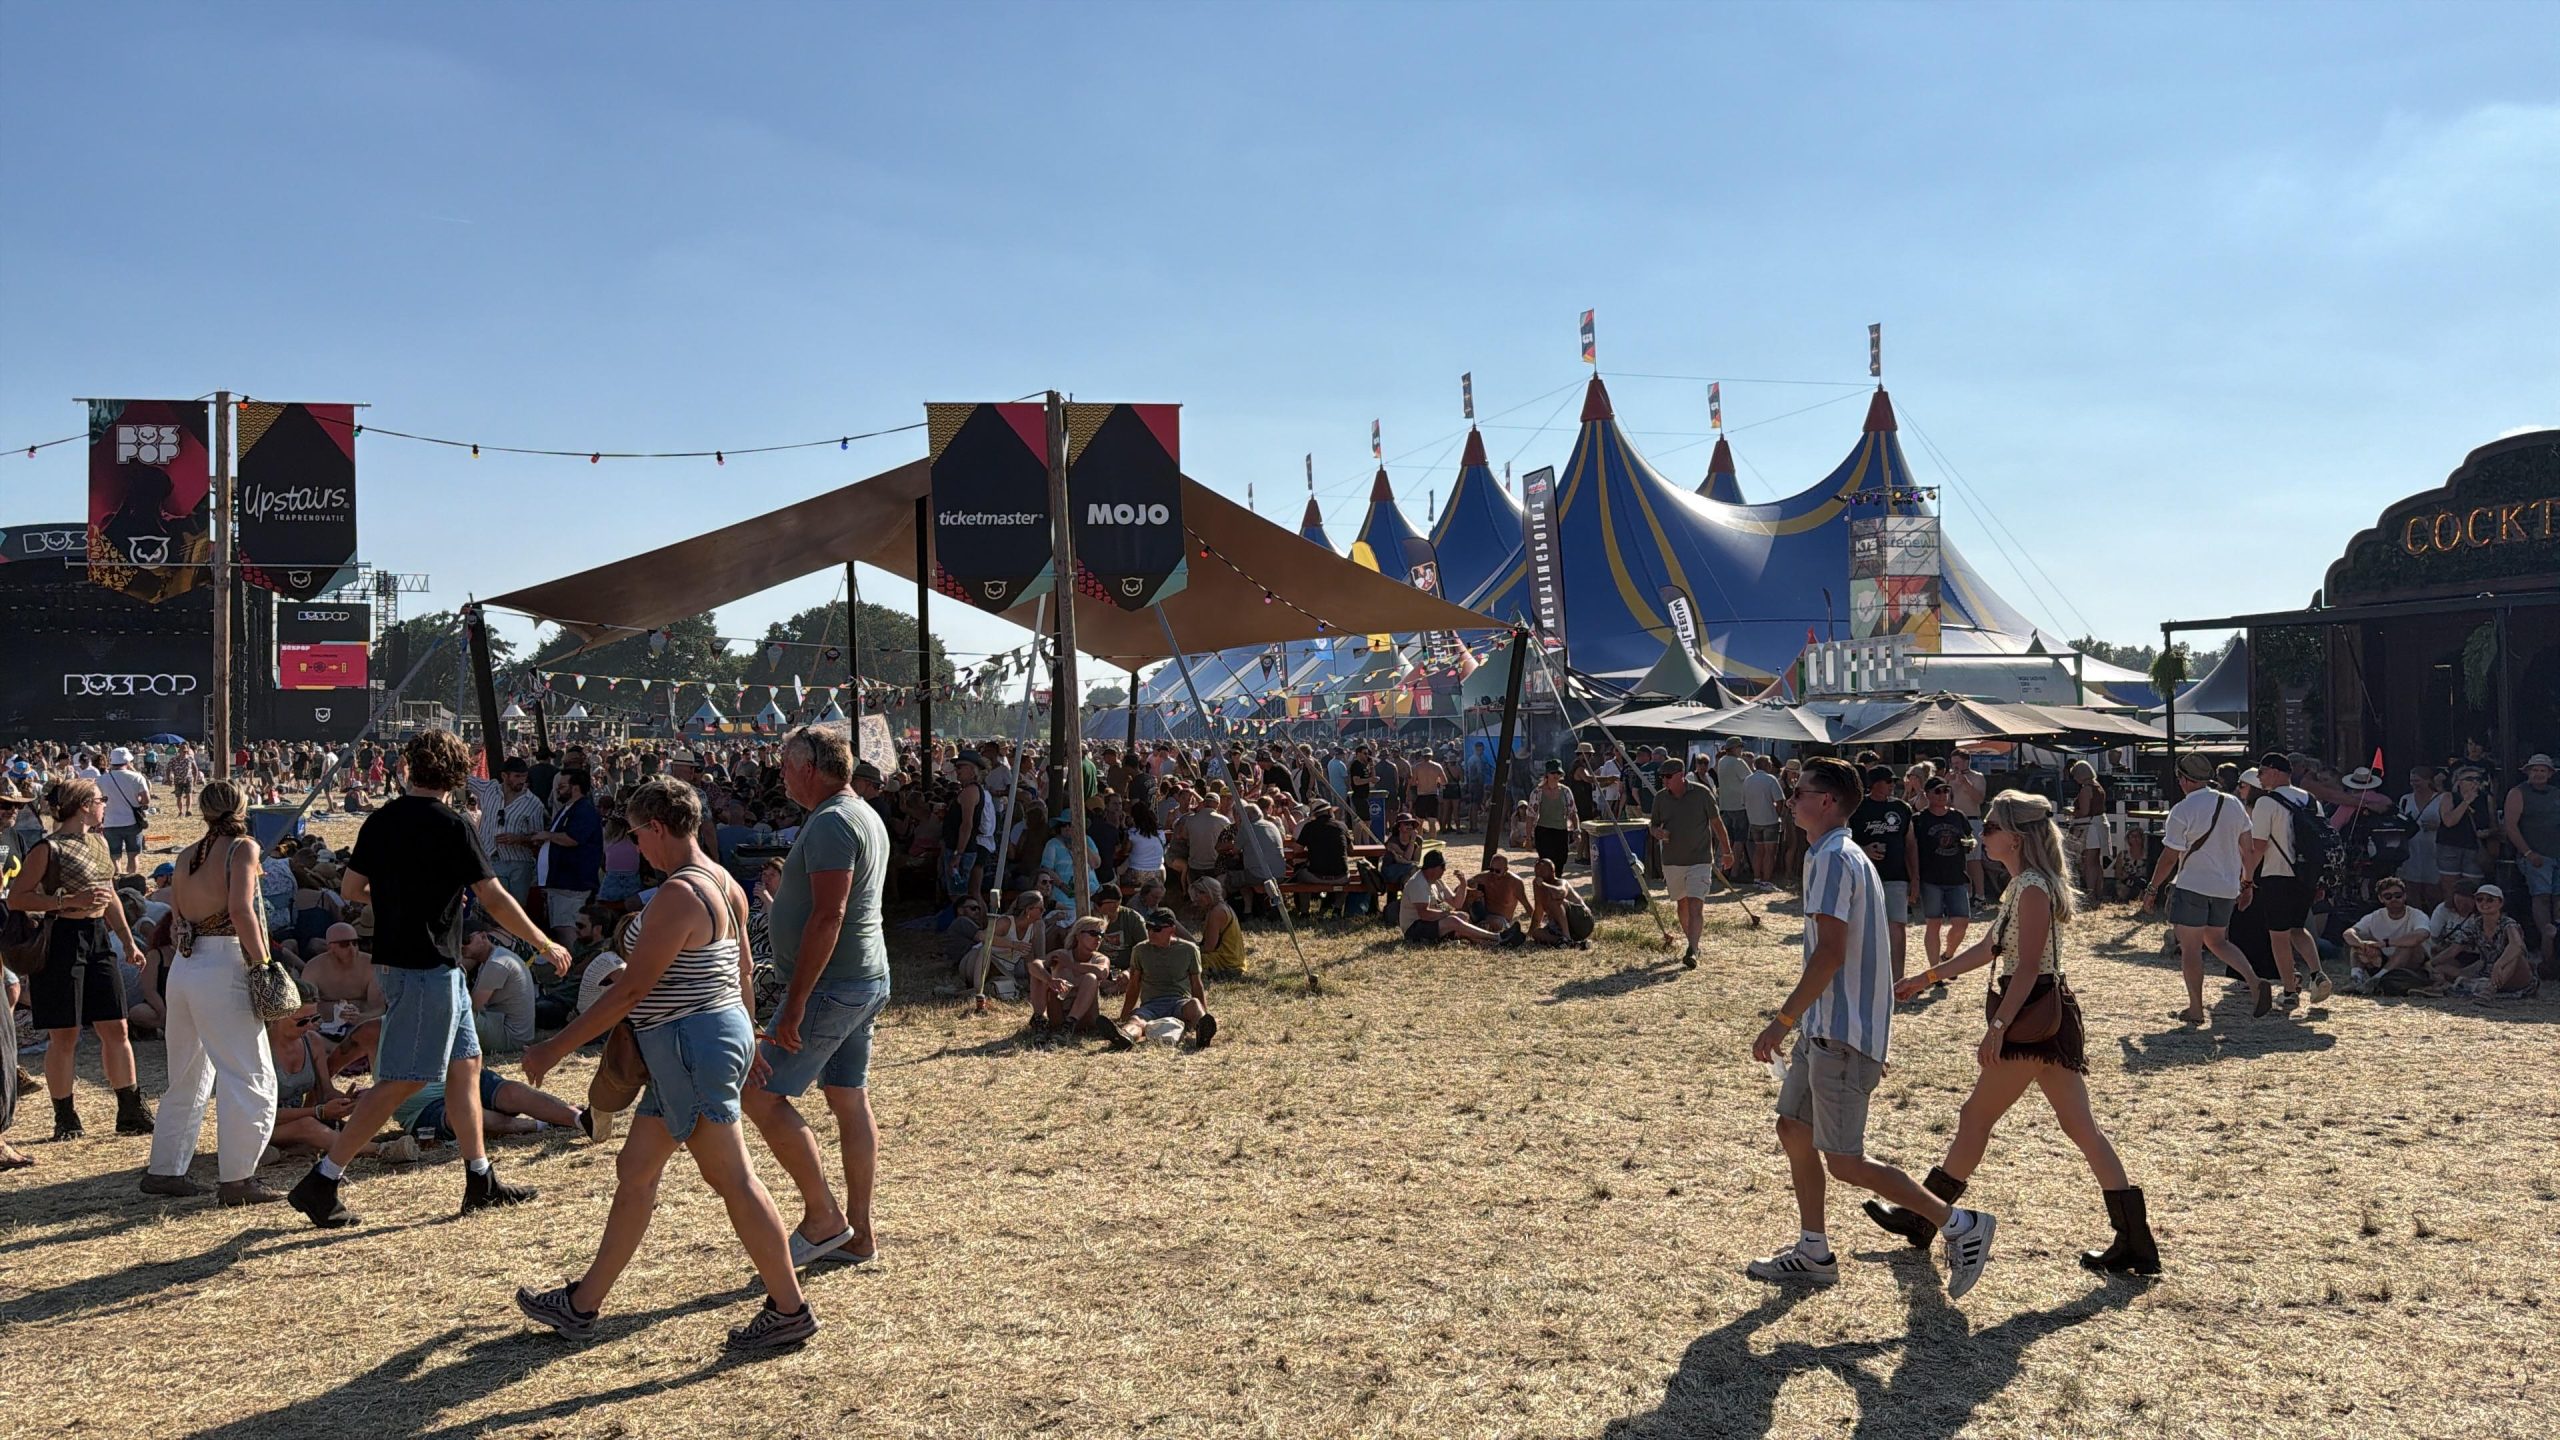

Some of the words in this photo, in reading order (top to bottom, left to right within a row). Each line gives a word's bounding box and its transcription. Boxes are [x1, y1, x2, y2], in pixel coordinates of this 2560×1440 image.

[117, 424, 180, 443] BOS
[117, 443, 180, 465] POP
[245, 484, 346, 522] Upstairs
[274, 514, 345, 522] TRAPRENOVATIE
[939, 510, 1037, 526] ticketmaster
[1087, 503, 1169, 525] MOJO
[2406, 499, 2560, 556] COCKT
[298, 611, 350, 621] BOSPOP
[63, 673, 197, 696] BOSPOP
[1420, 695, 1433, 711] BAR
